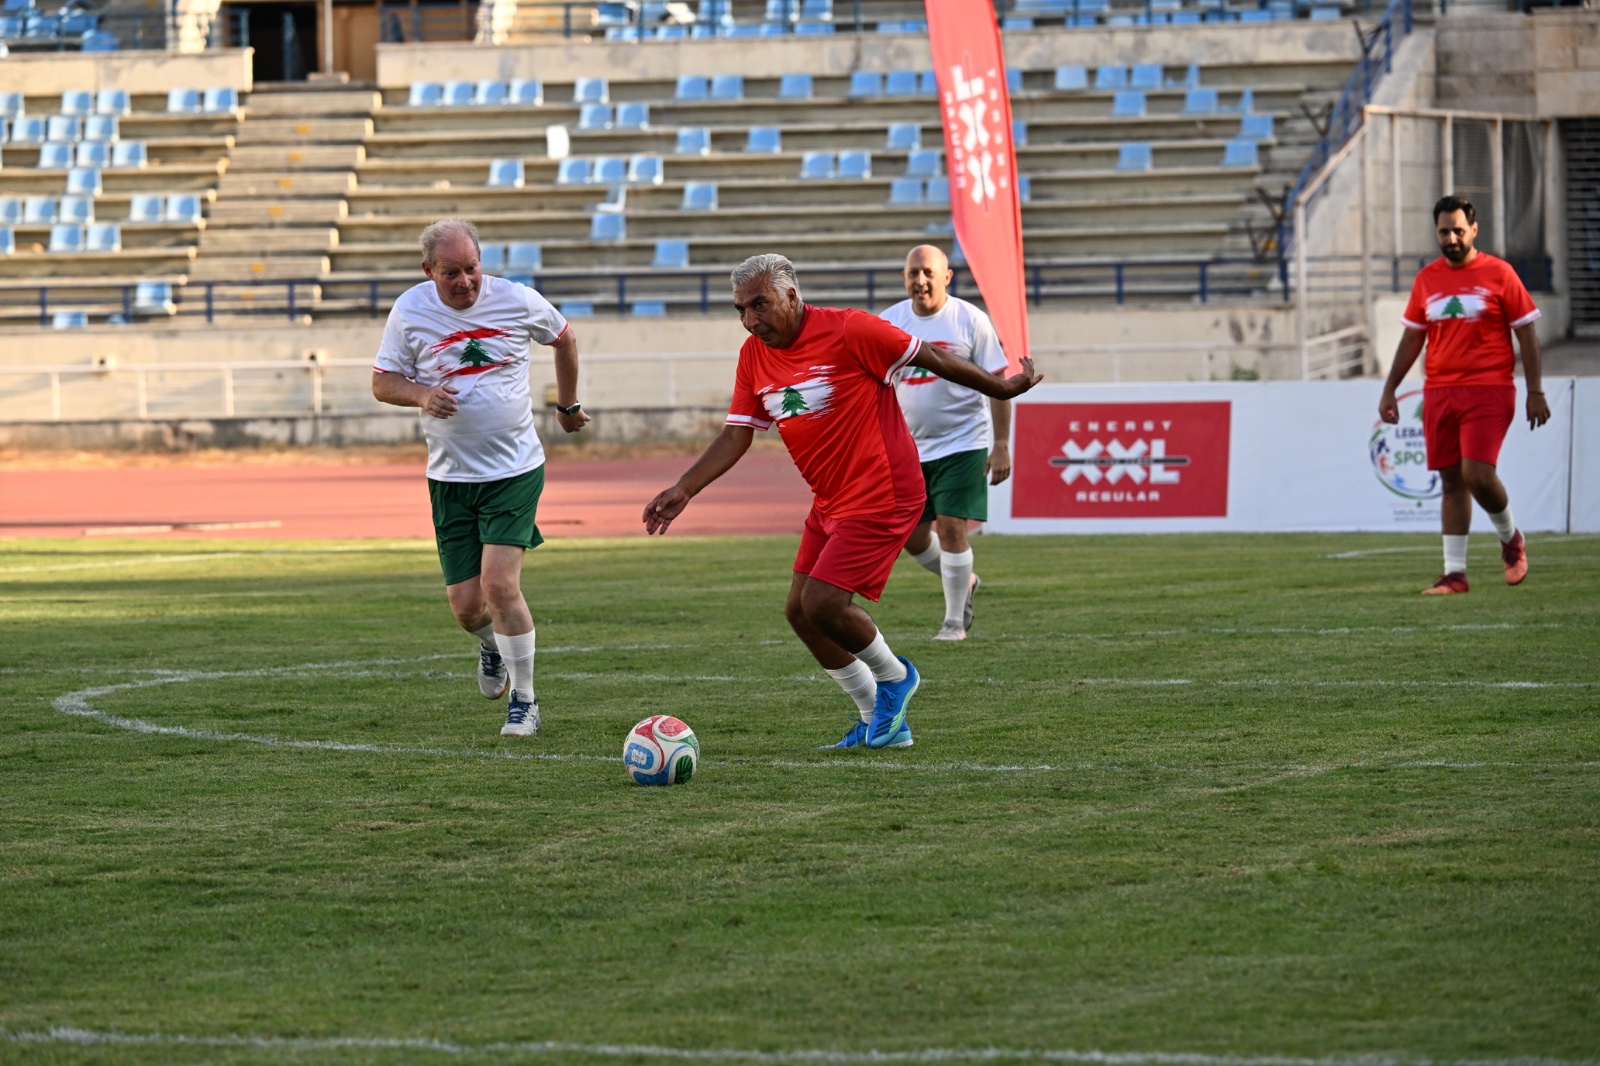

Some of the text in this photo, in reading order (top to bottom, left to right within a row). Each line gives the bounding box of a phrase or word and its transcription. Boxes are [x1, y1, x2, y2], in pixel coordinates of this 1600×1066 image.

[1069, 421, 1172, 432] ENERGY
[1395, 427, 1425, 439] LEBA
[1060, 437, 1180, 486] XXL
[1394, 450, 1426, 466] SPO
[1076, 491, 1160, 502] REGULAR
